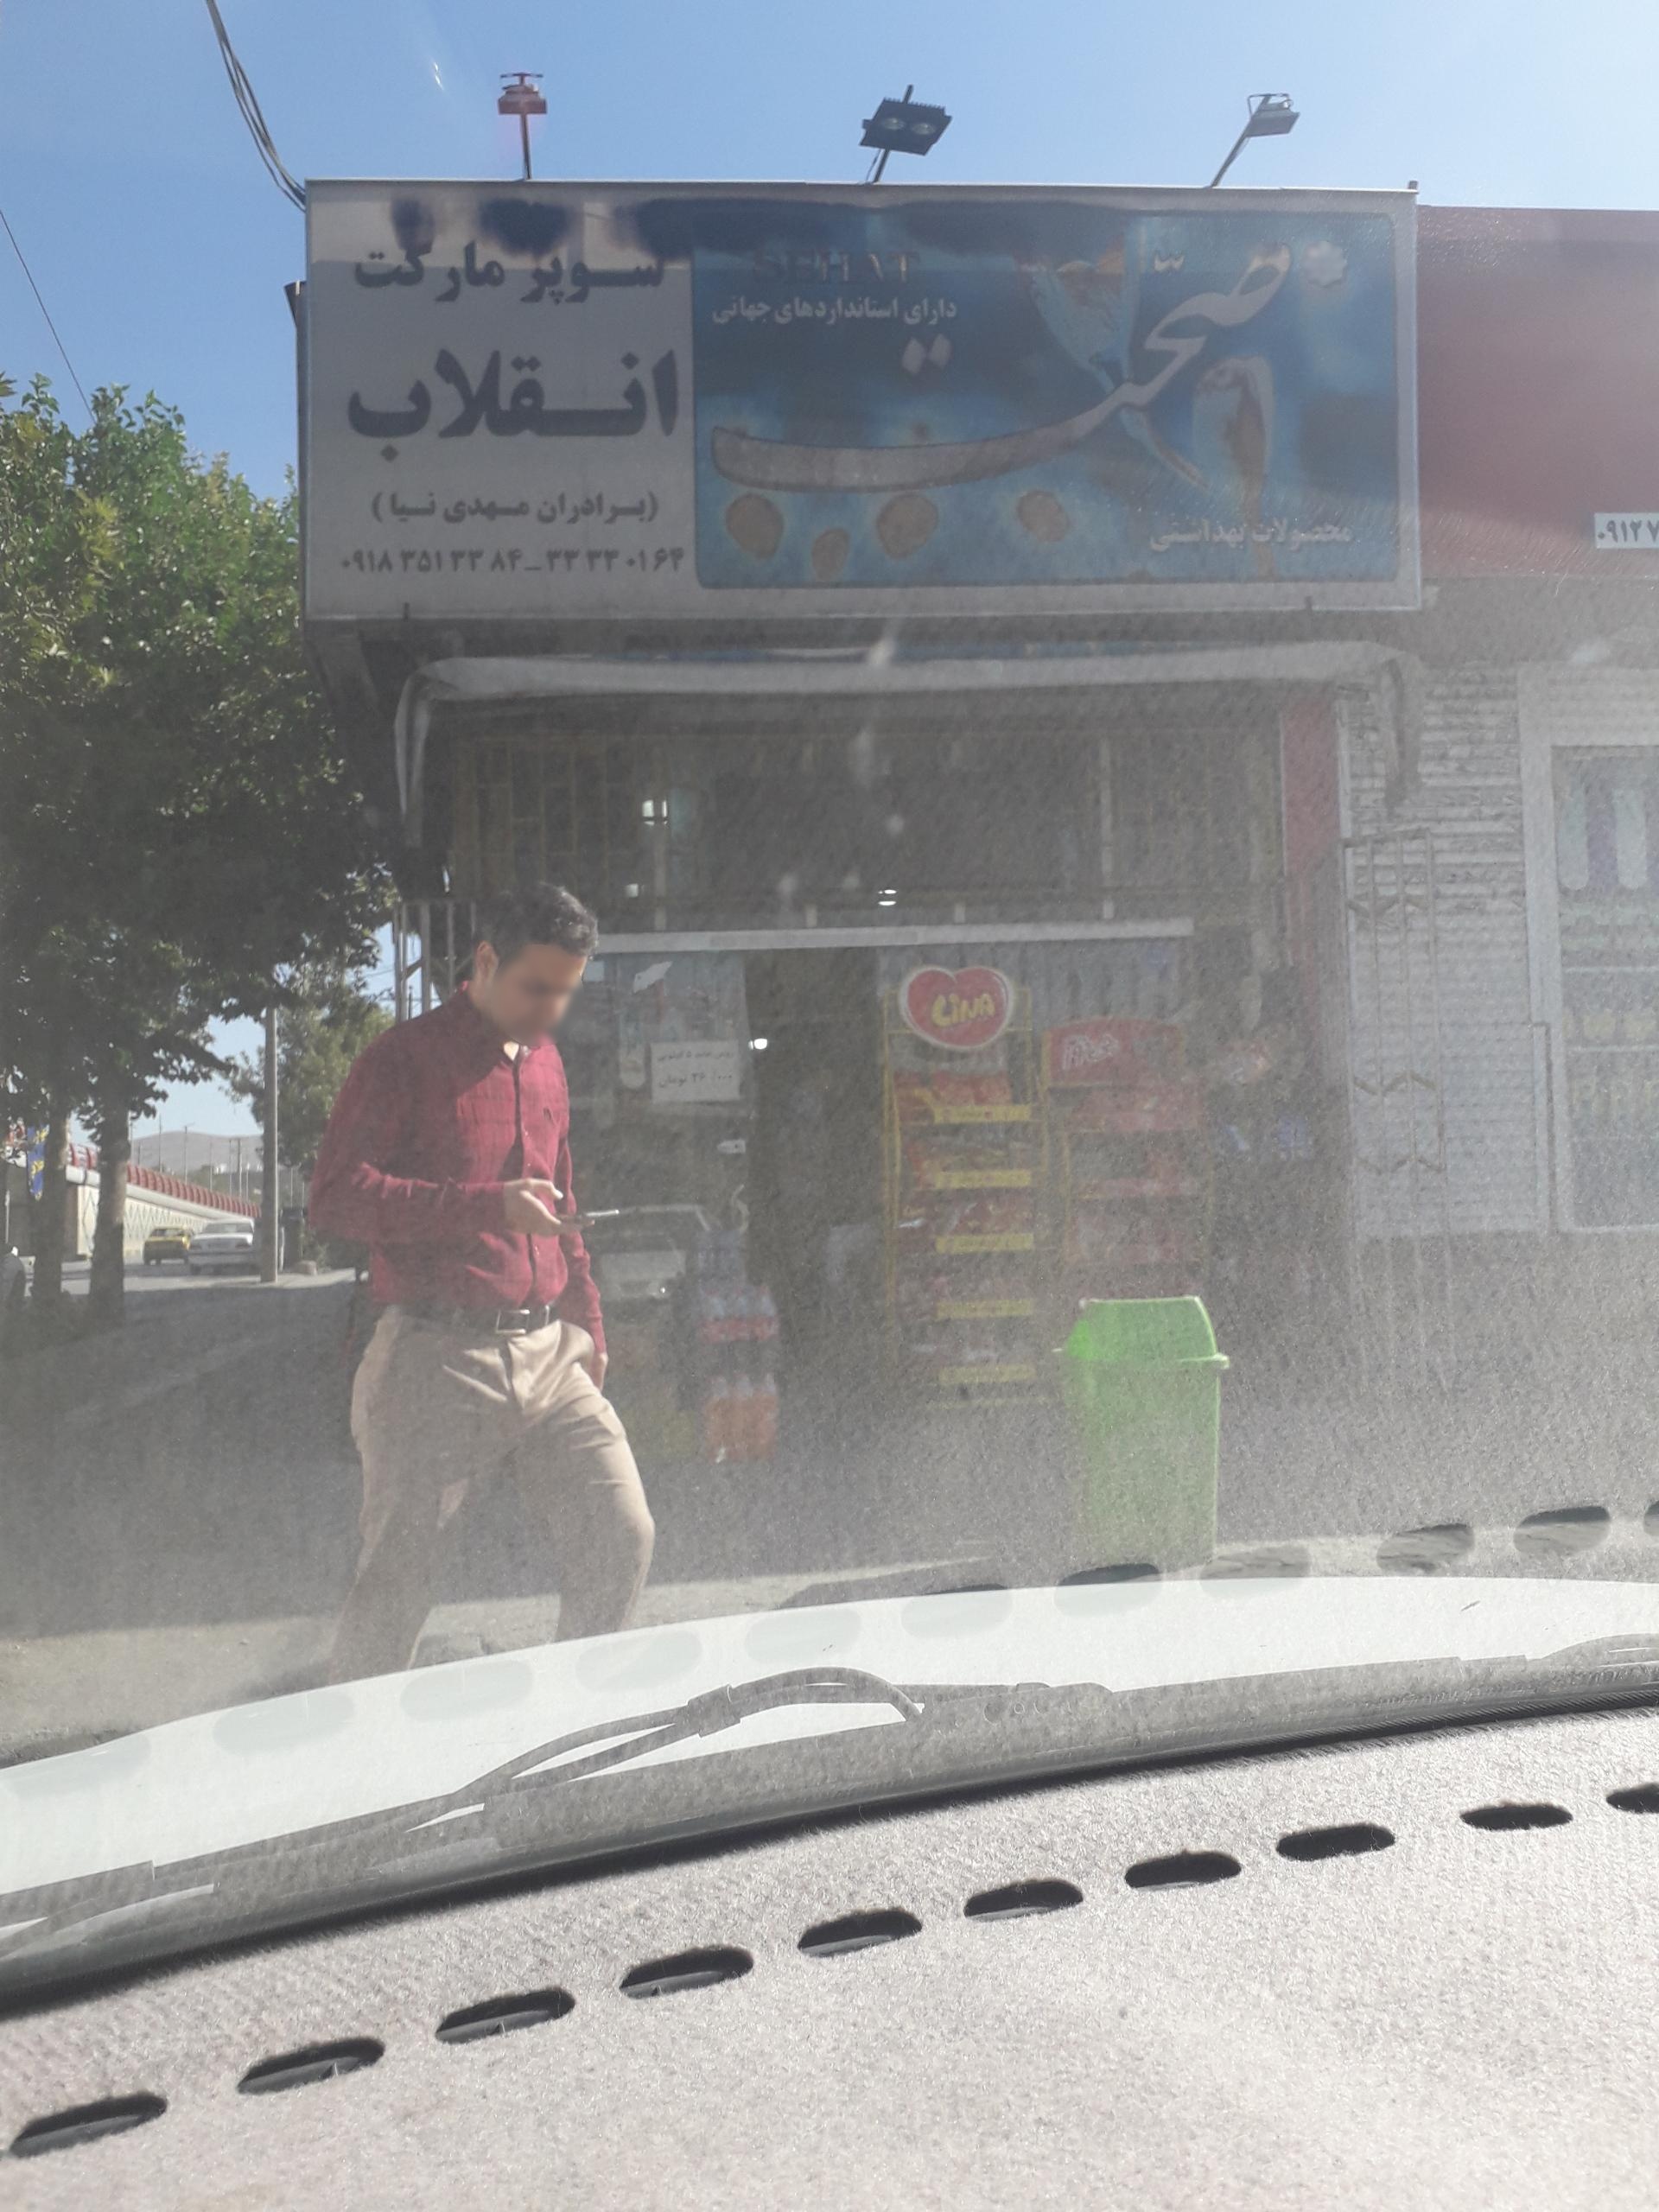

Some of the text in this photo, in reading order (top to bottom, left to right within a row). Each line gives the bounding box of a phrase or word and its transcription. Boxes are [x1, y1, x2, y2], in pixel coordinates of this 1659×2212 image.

[354, 240, 665, 304] سوپر مارکت
[712, 295, 957, 325] دارای استانداردهای جهانی
[347, 348, 679, 462] انقلاب
[442, 496, 530, 524] مهدی
